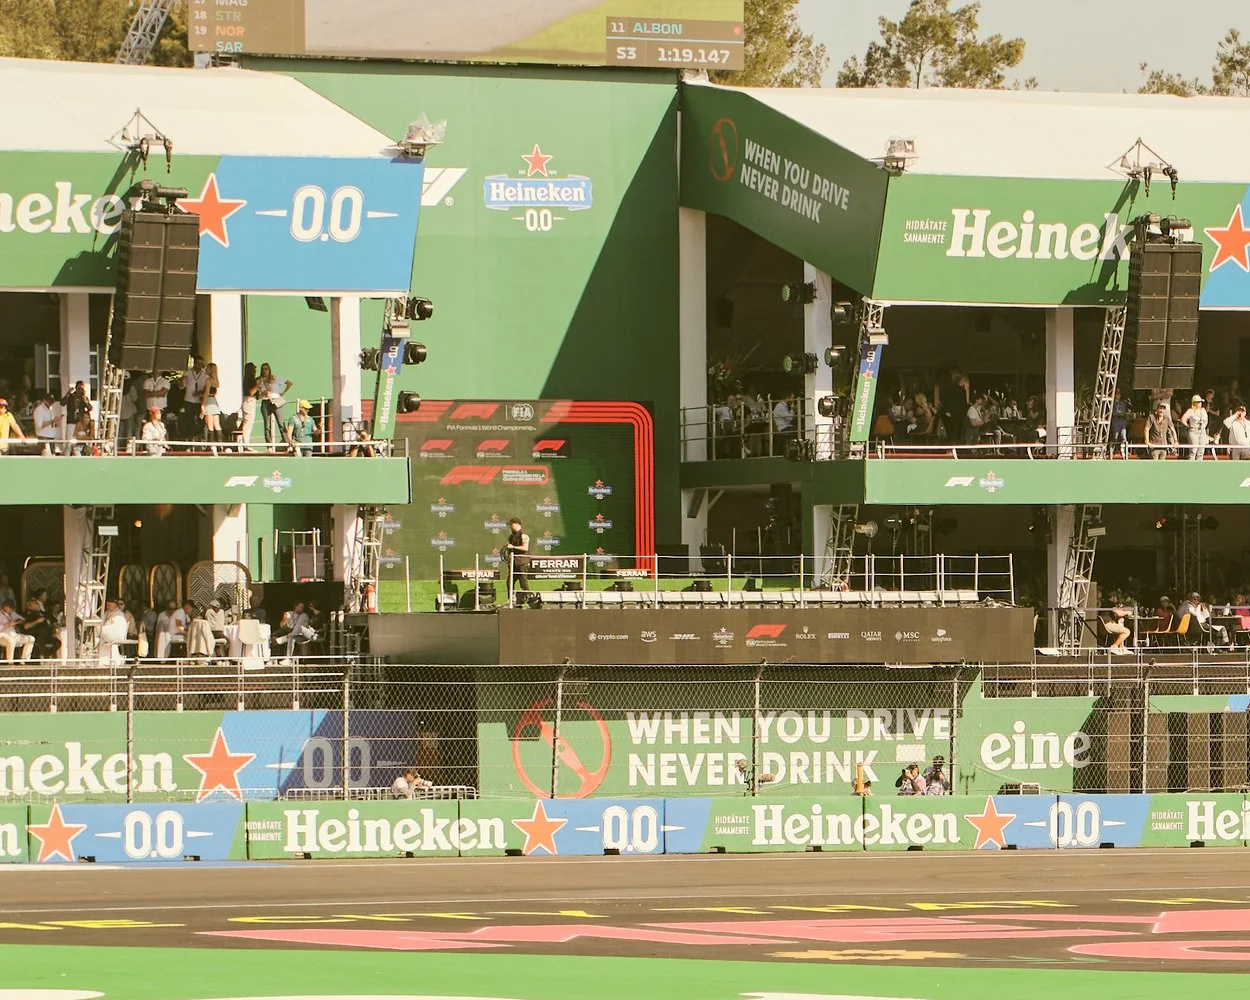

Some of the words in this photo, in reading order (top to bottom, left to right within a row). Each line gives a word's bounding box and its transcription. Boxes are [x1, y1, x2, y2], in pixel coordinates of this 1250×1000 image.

[194, 10, 207, 20] 18
[215, 10, 242, 22] STR
[194, 25, 207, 35] 19
[215, 25, 245, 37] NOR
[611, 22, 625, 33] 11
[633, 22, 682, 35] ALBON
[215, 41, 244, 53] SAR
[616, 46, 637, 60] S3
[658, 47, 730, 64] 1:19.147
[745, 138, 781, 176] WHEN
[784, 158, 810, 190] YOU
[812, 173, 850, 211] DRIVE
[489, 182, 586, 202] Heineken
[740, 163, 779, 202] NEVER
[781, 184, 822, 224] DRINK
[290, 184, 364, 243] 0.0
[526, 208, 552, 232] 0.0
[905, 218, 947, 231] HIDRÁTATE
[903, 233, 945, 244] SANAMENTE
[946, 208, 1195, 261] Heinek
[532, 559, 578, 568] FERRARI
[627, 711, 740, 745] WHEN
[756, 710, 831, 744] YOU
[847, 708, 951, 742] DRIVE
[629, 752, 747, 786] NEVER
[762, 750, 880, 785] DRINK
[715, 814, 750, 824] HIDRÁTATE
[752, 804, 961, 845] Heineken
[1048, 800, 1101, 847] 0.0
[1151, 810, 1184, 820] HIDRÁTATE
[124, 810, 184, 859] 0.0
[284, 808, 508, 852] Heineken
[602, 805, 658, 852] 0.0
[715, 826, 750, 835] SANAMENTE
[1151, 822, 1184, 831] SANAMENTE
[227, 909, 611, 924] CITY
[651, 899, 1080, 915] THAT
